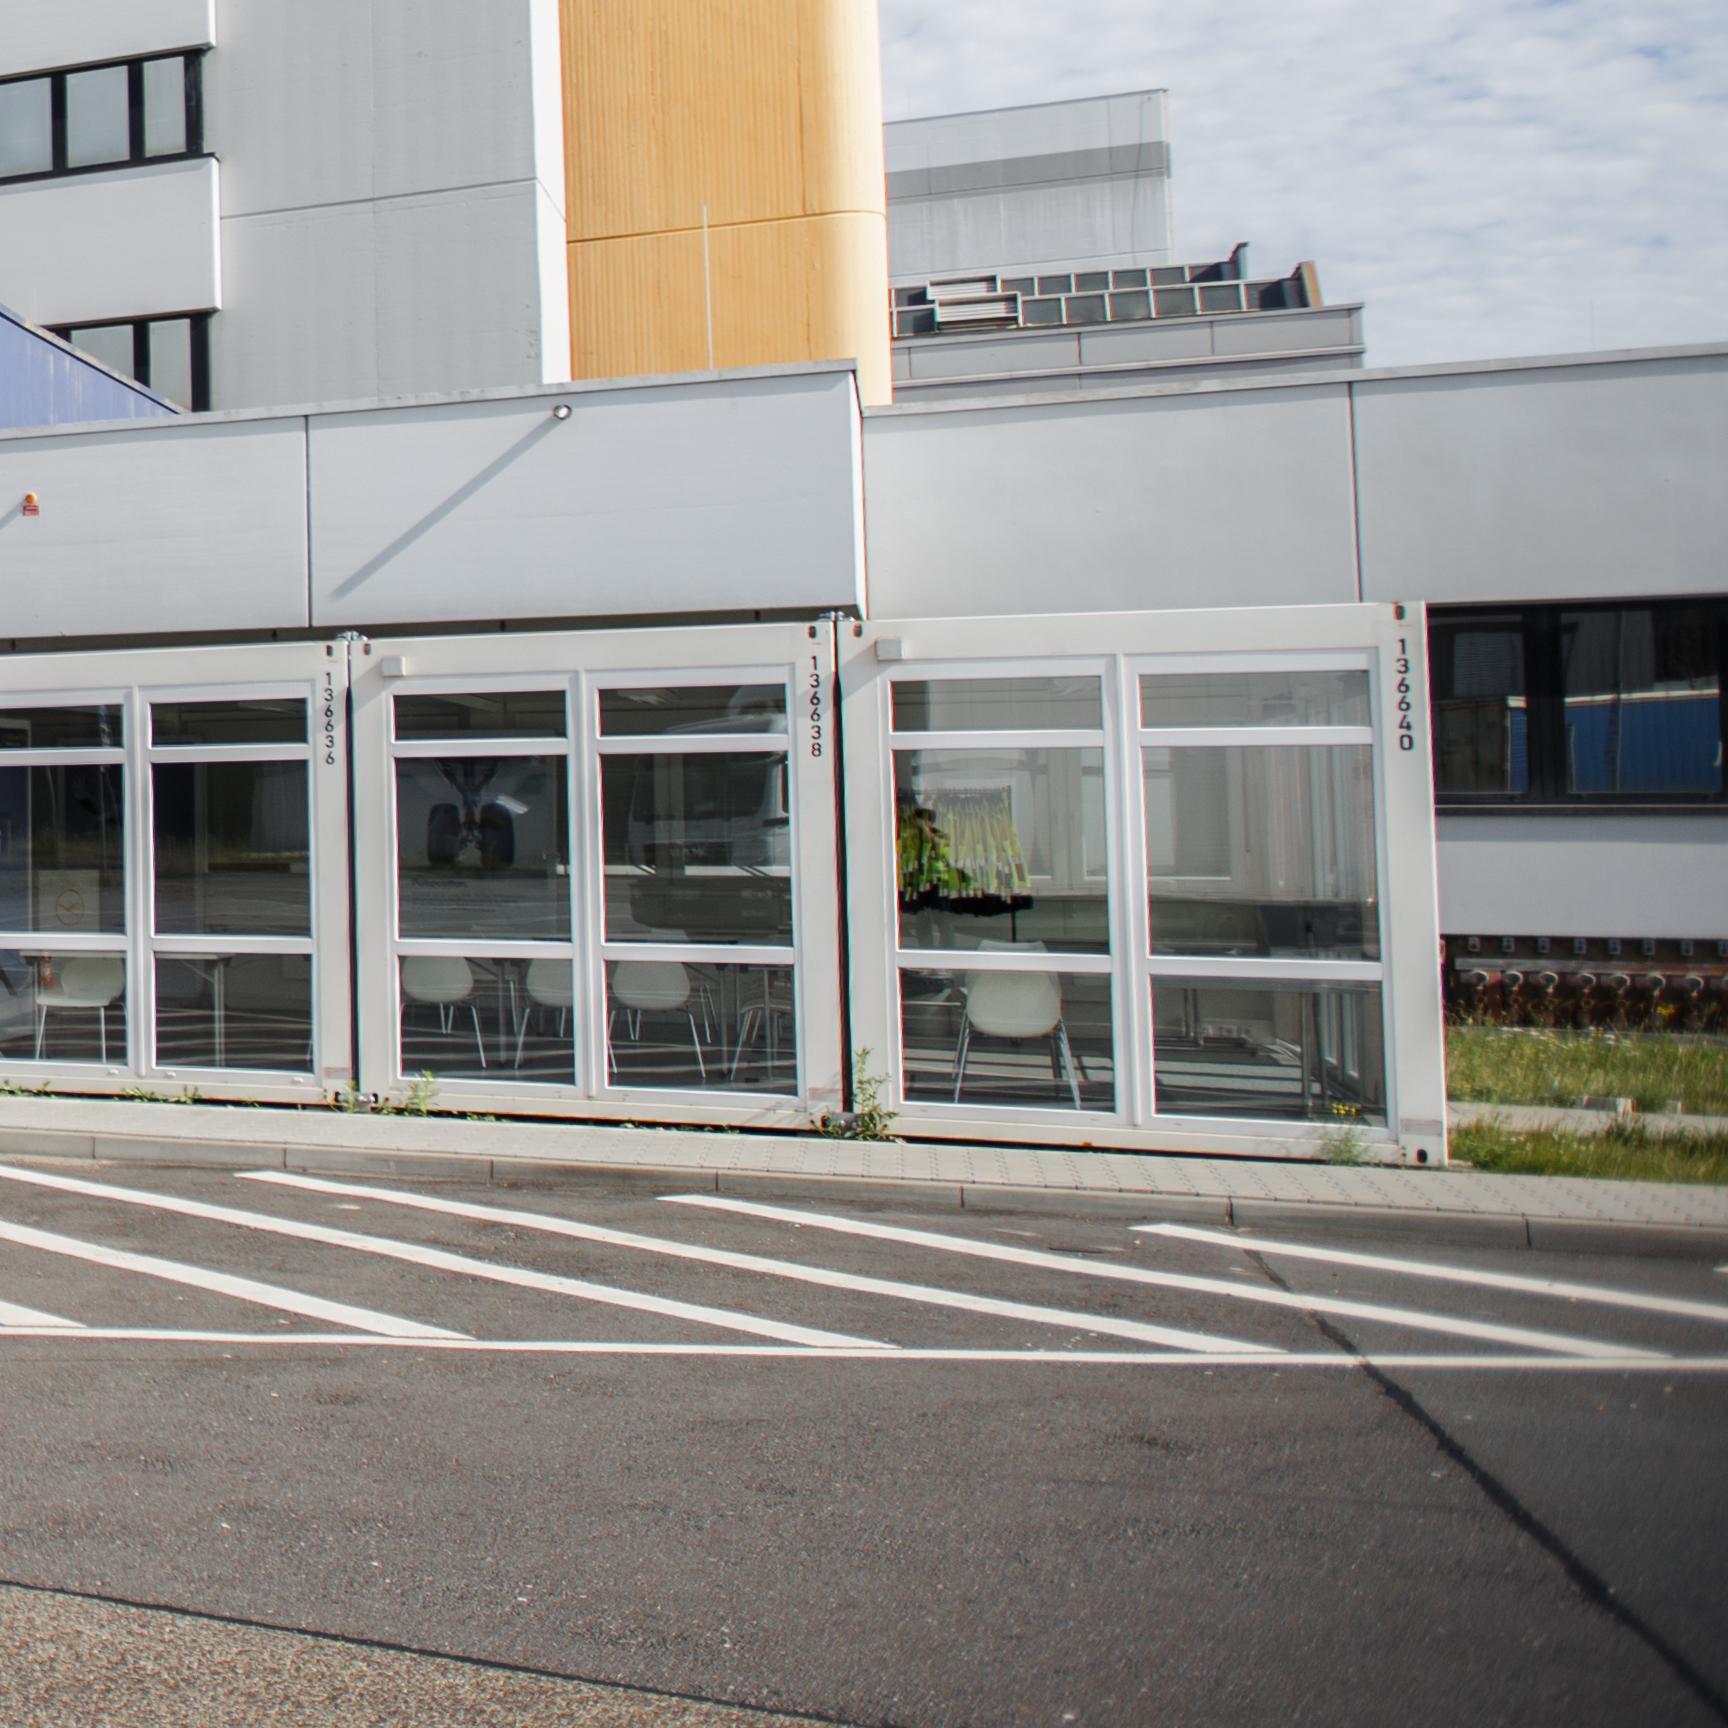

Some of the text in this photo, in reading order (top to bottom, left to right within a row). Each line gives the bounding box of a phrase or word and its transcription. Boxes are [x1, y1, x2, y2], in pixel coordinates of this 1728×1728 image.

[324, 671, 335, 765] 136636
[809, 655, 822, 758] 136638
[1396, 638, 1414, 751] 136640
